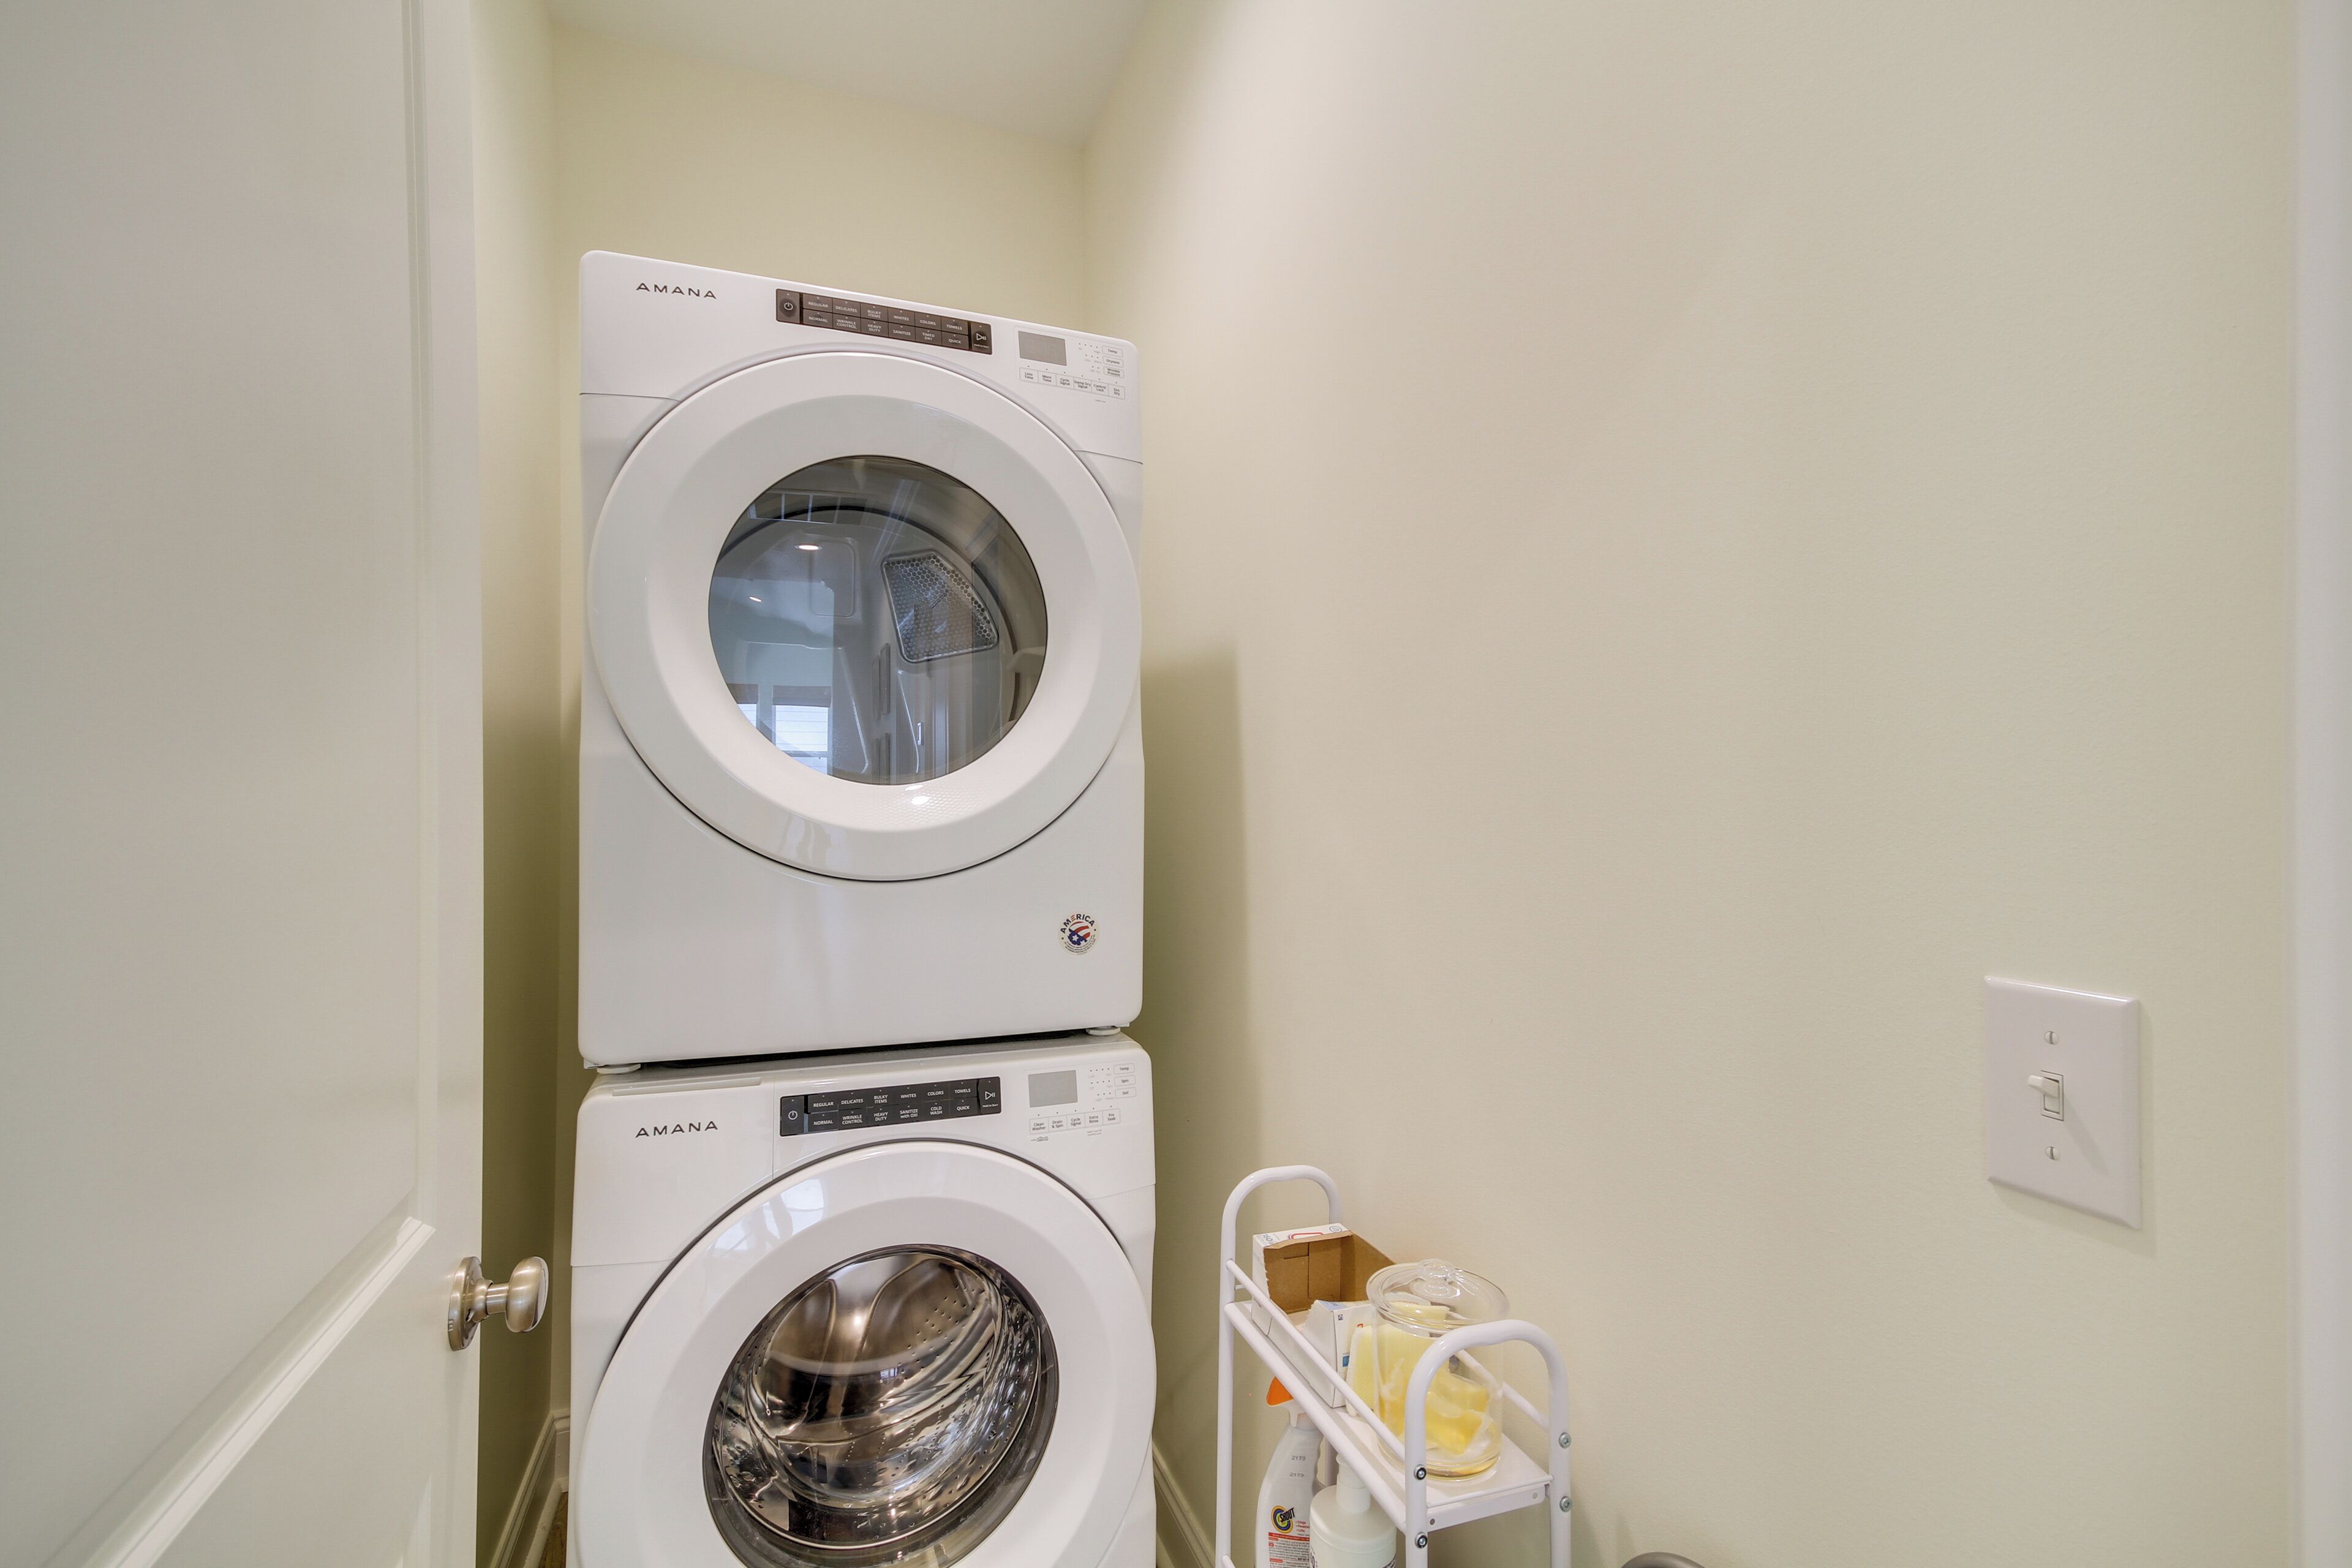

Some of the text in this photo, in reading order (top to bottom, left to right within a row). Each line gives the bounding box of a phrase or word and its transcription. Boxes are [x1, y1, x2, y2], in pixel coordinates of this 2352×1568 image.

[636, 282, 717, 300] AMANA
[1060, 913, 1095, 934] AMERICA
[635, 1120, 718, 1138] AMANA
[1280, 1507, 1295, 1523] SHOUT
